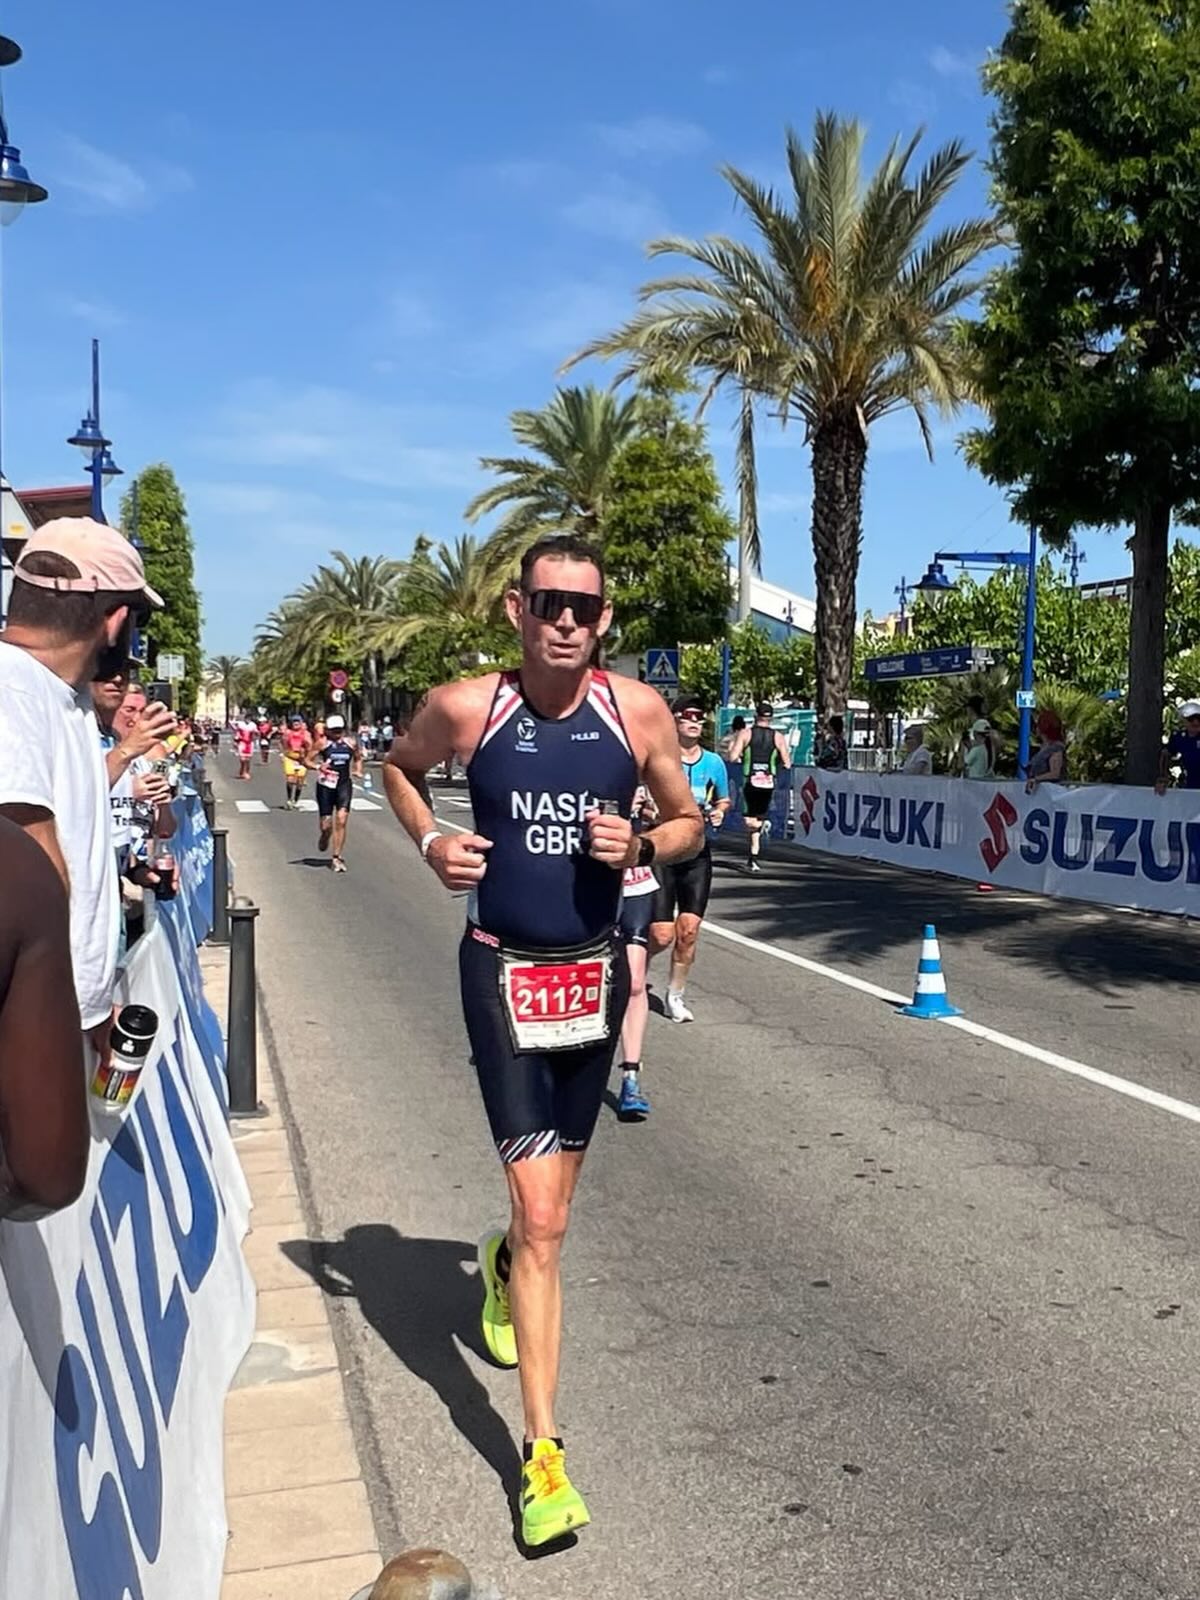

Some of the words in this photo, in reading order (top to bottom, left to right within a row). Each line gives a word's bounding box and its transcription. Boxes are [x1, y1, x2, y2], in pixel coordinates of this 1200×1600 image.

[511, 790, 599, 823] NASH
[823, 789, 945, 850] SUZUKI
[526, 824, 584, 855] GBR
[516, 984, 583, 1015] 2112
[53, 1016, 226, 1600] SUZU
